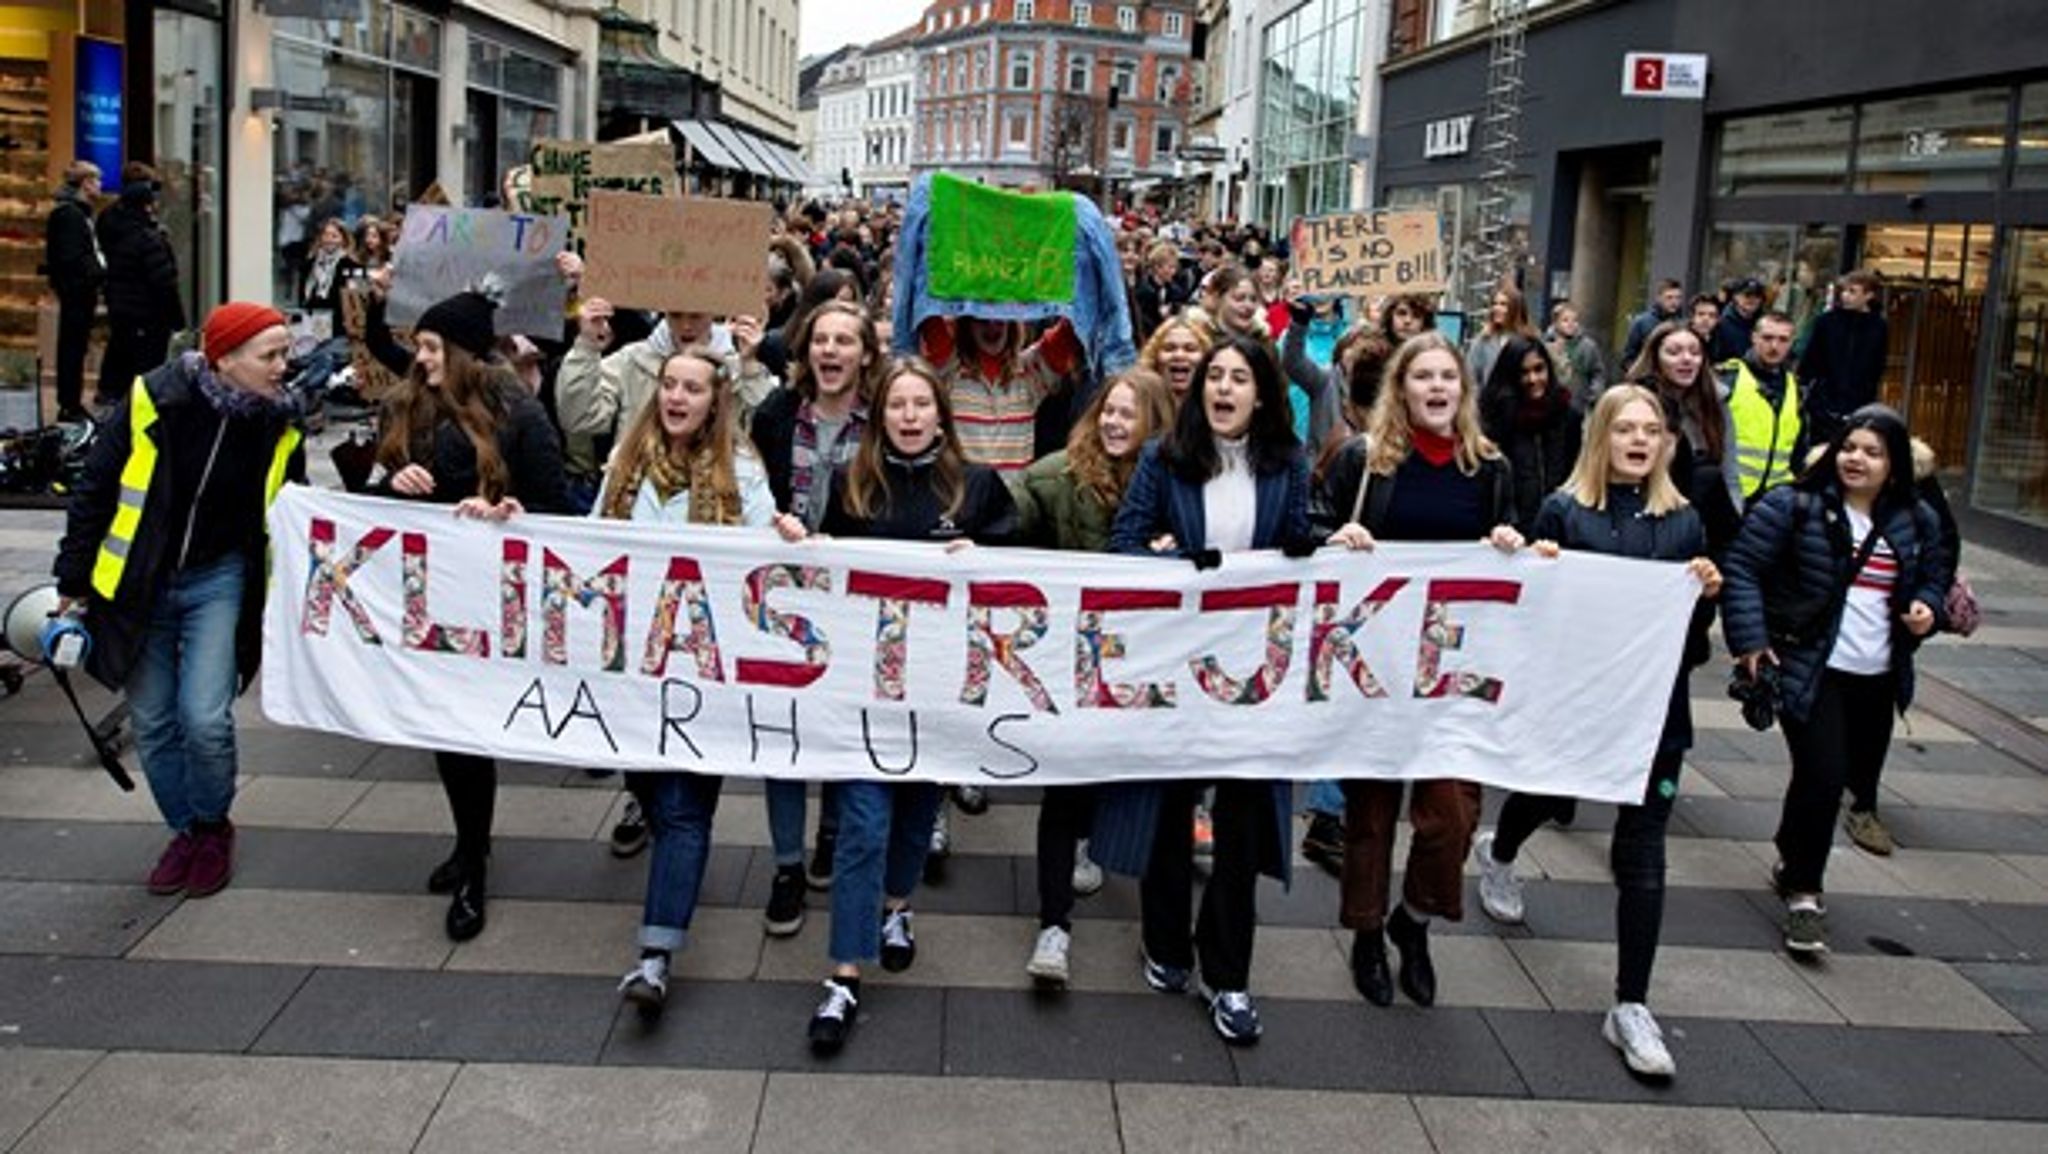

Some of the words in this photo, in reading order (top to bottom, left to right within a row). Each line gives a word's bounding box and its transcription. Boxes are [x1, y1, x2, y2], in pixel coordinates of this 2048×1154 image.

[1424, 115, 1474, 158] LILLY
[508, 214, 552, 253] TO
[1306, 210, 1389, 248] THERE
[1316, 243, 1348, 264] IS
[1360, 238, 1395, 259] NO
[1302, 263, 1390, 291] PLANET
[302, 517, 1523, 716] KLIMASTREJKE
[503, 677, 1038, 780] AARHUS
